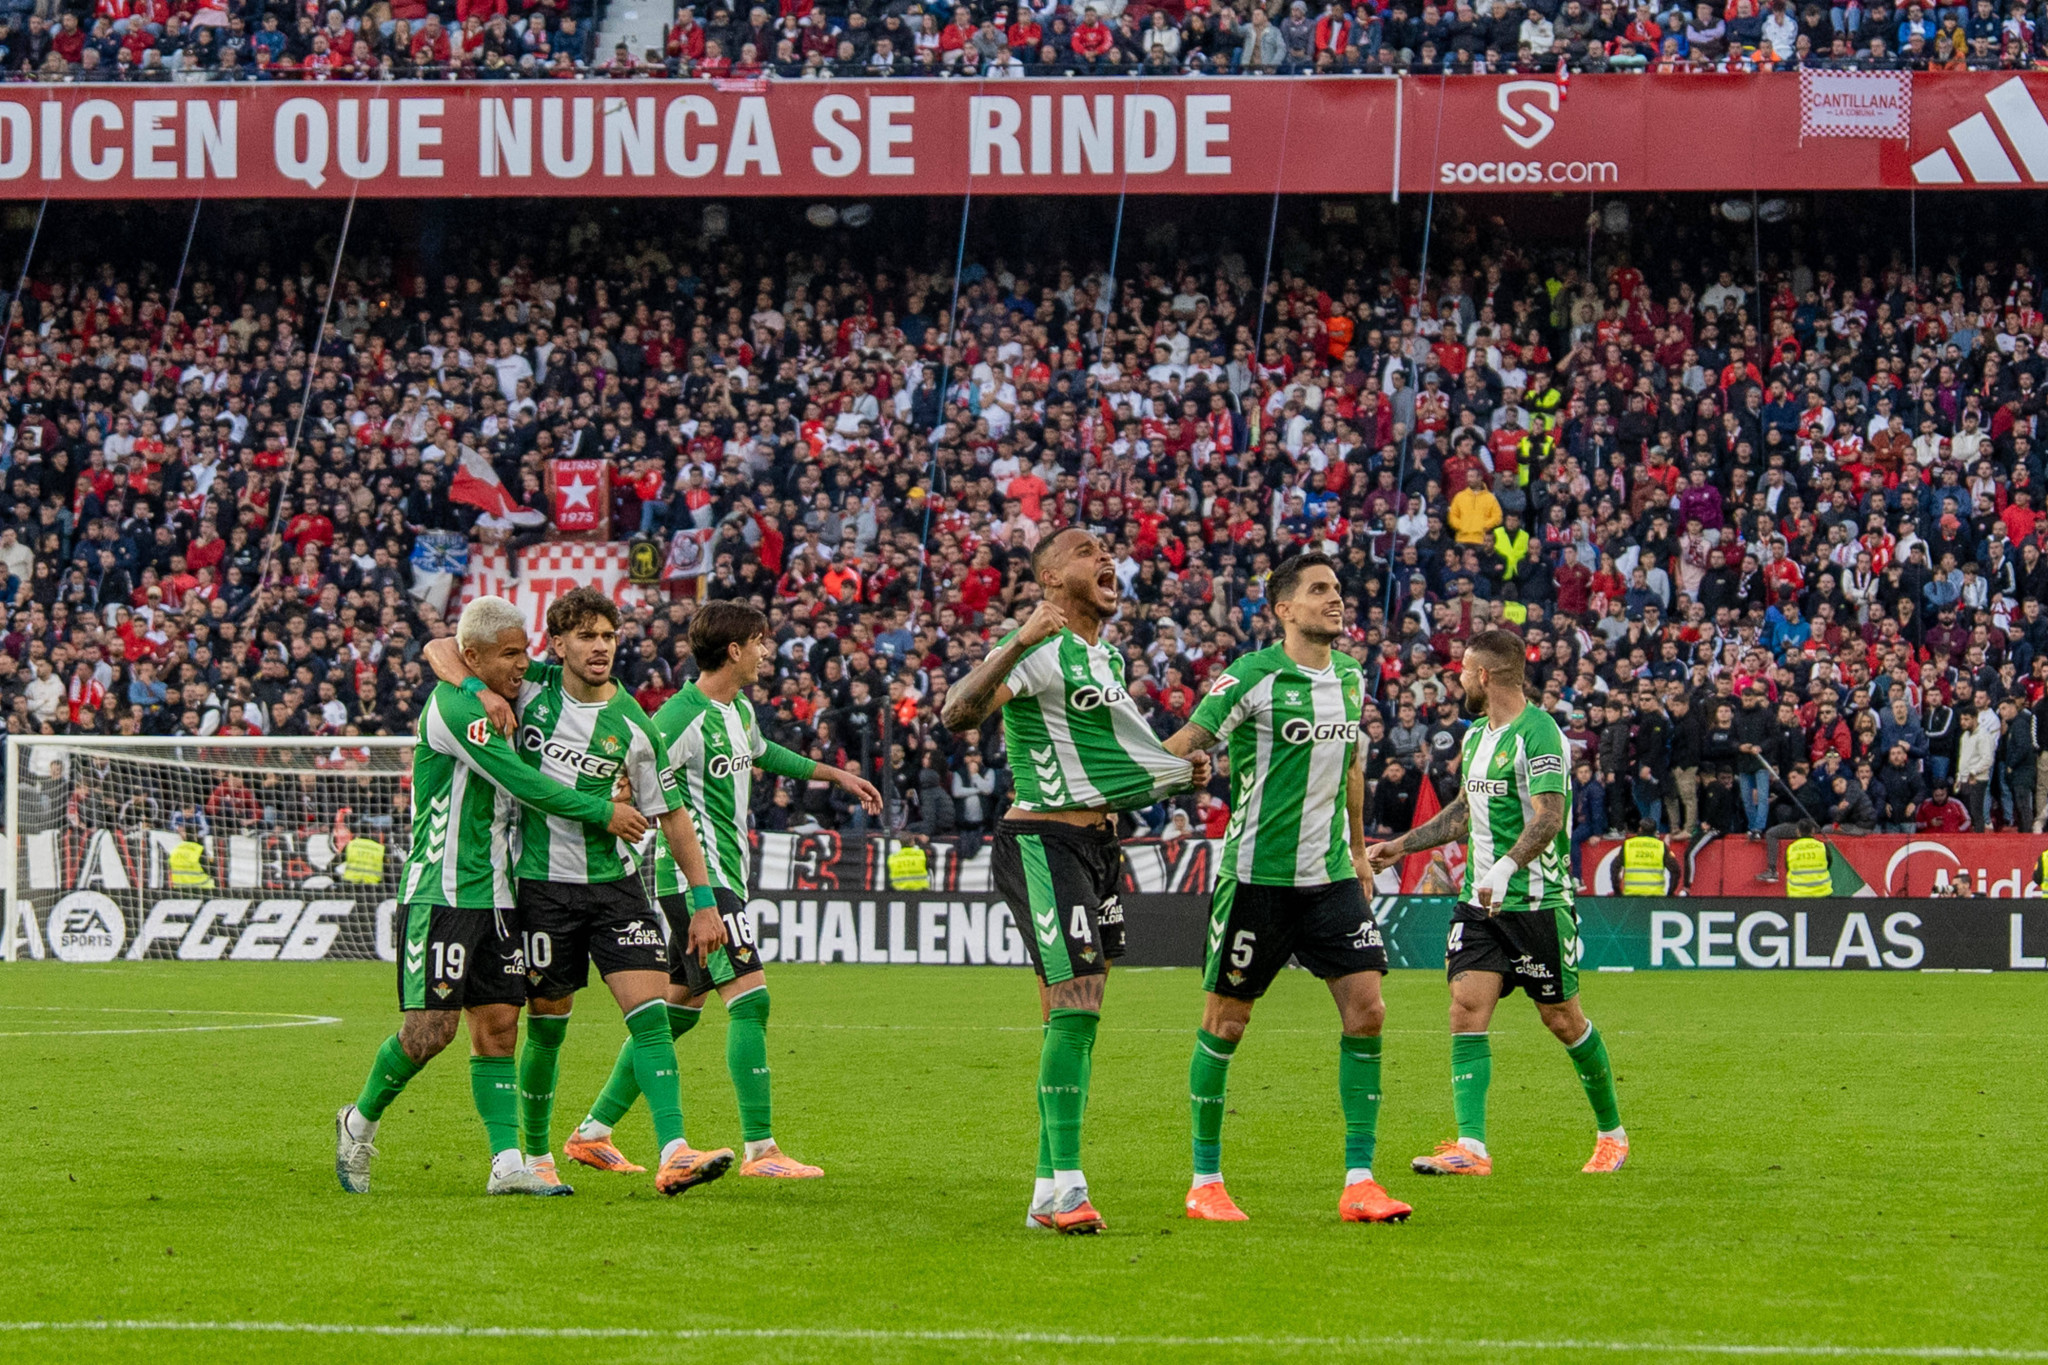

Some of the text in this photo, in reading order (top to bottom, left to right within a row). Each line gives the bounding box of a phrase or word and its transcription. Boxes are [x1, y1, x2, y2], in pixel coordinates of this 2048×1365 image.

[1812, 92, 1898, 108] CANTILLANA
[0, 94, 1232, 189] DICEN QUE NUNCA SE RINDE
[1440, 161, 1618, 184] socios.com
[558, 460, 598, 472] ULTRAS
[560, 511, 595, 523] 1975
[1314, 723, 1358, 741] GRE
[544, 742, 616, 778] GREE
[731, 755, 752, 773] GR
[1467, 779, 1506, 795] GREE
[63, 908, 111, 934] EA
[722, 911, 753, 948] 16
[1070, 905, 1092, 943] 4
[61, 935, 113, 947] SPORTS
[617, 937, 665, 947] GLOBAL
[634, 929, 658, 938] AUS
[745, 900, 1034, 965] CHALLENG
[1651, 911, 1925, 969] REGLAS
[521, 931, 552, 968] 10
[1230, 929, 1257, 968] 5
[432, 941, 466, 980] 19
[1526, 963, 1546, 972] AUS
[1515, 966, 1554, 978] GLOBAL
